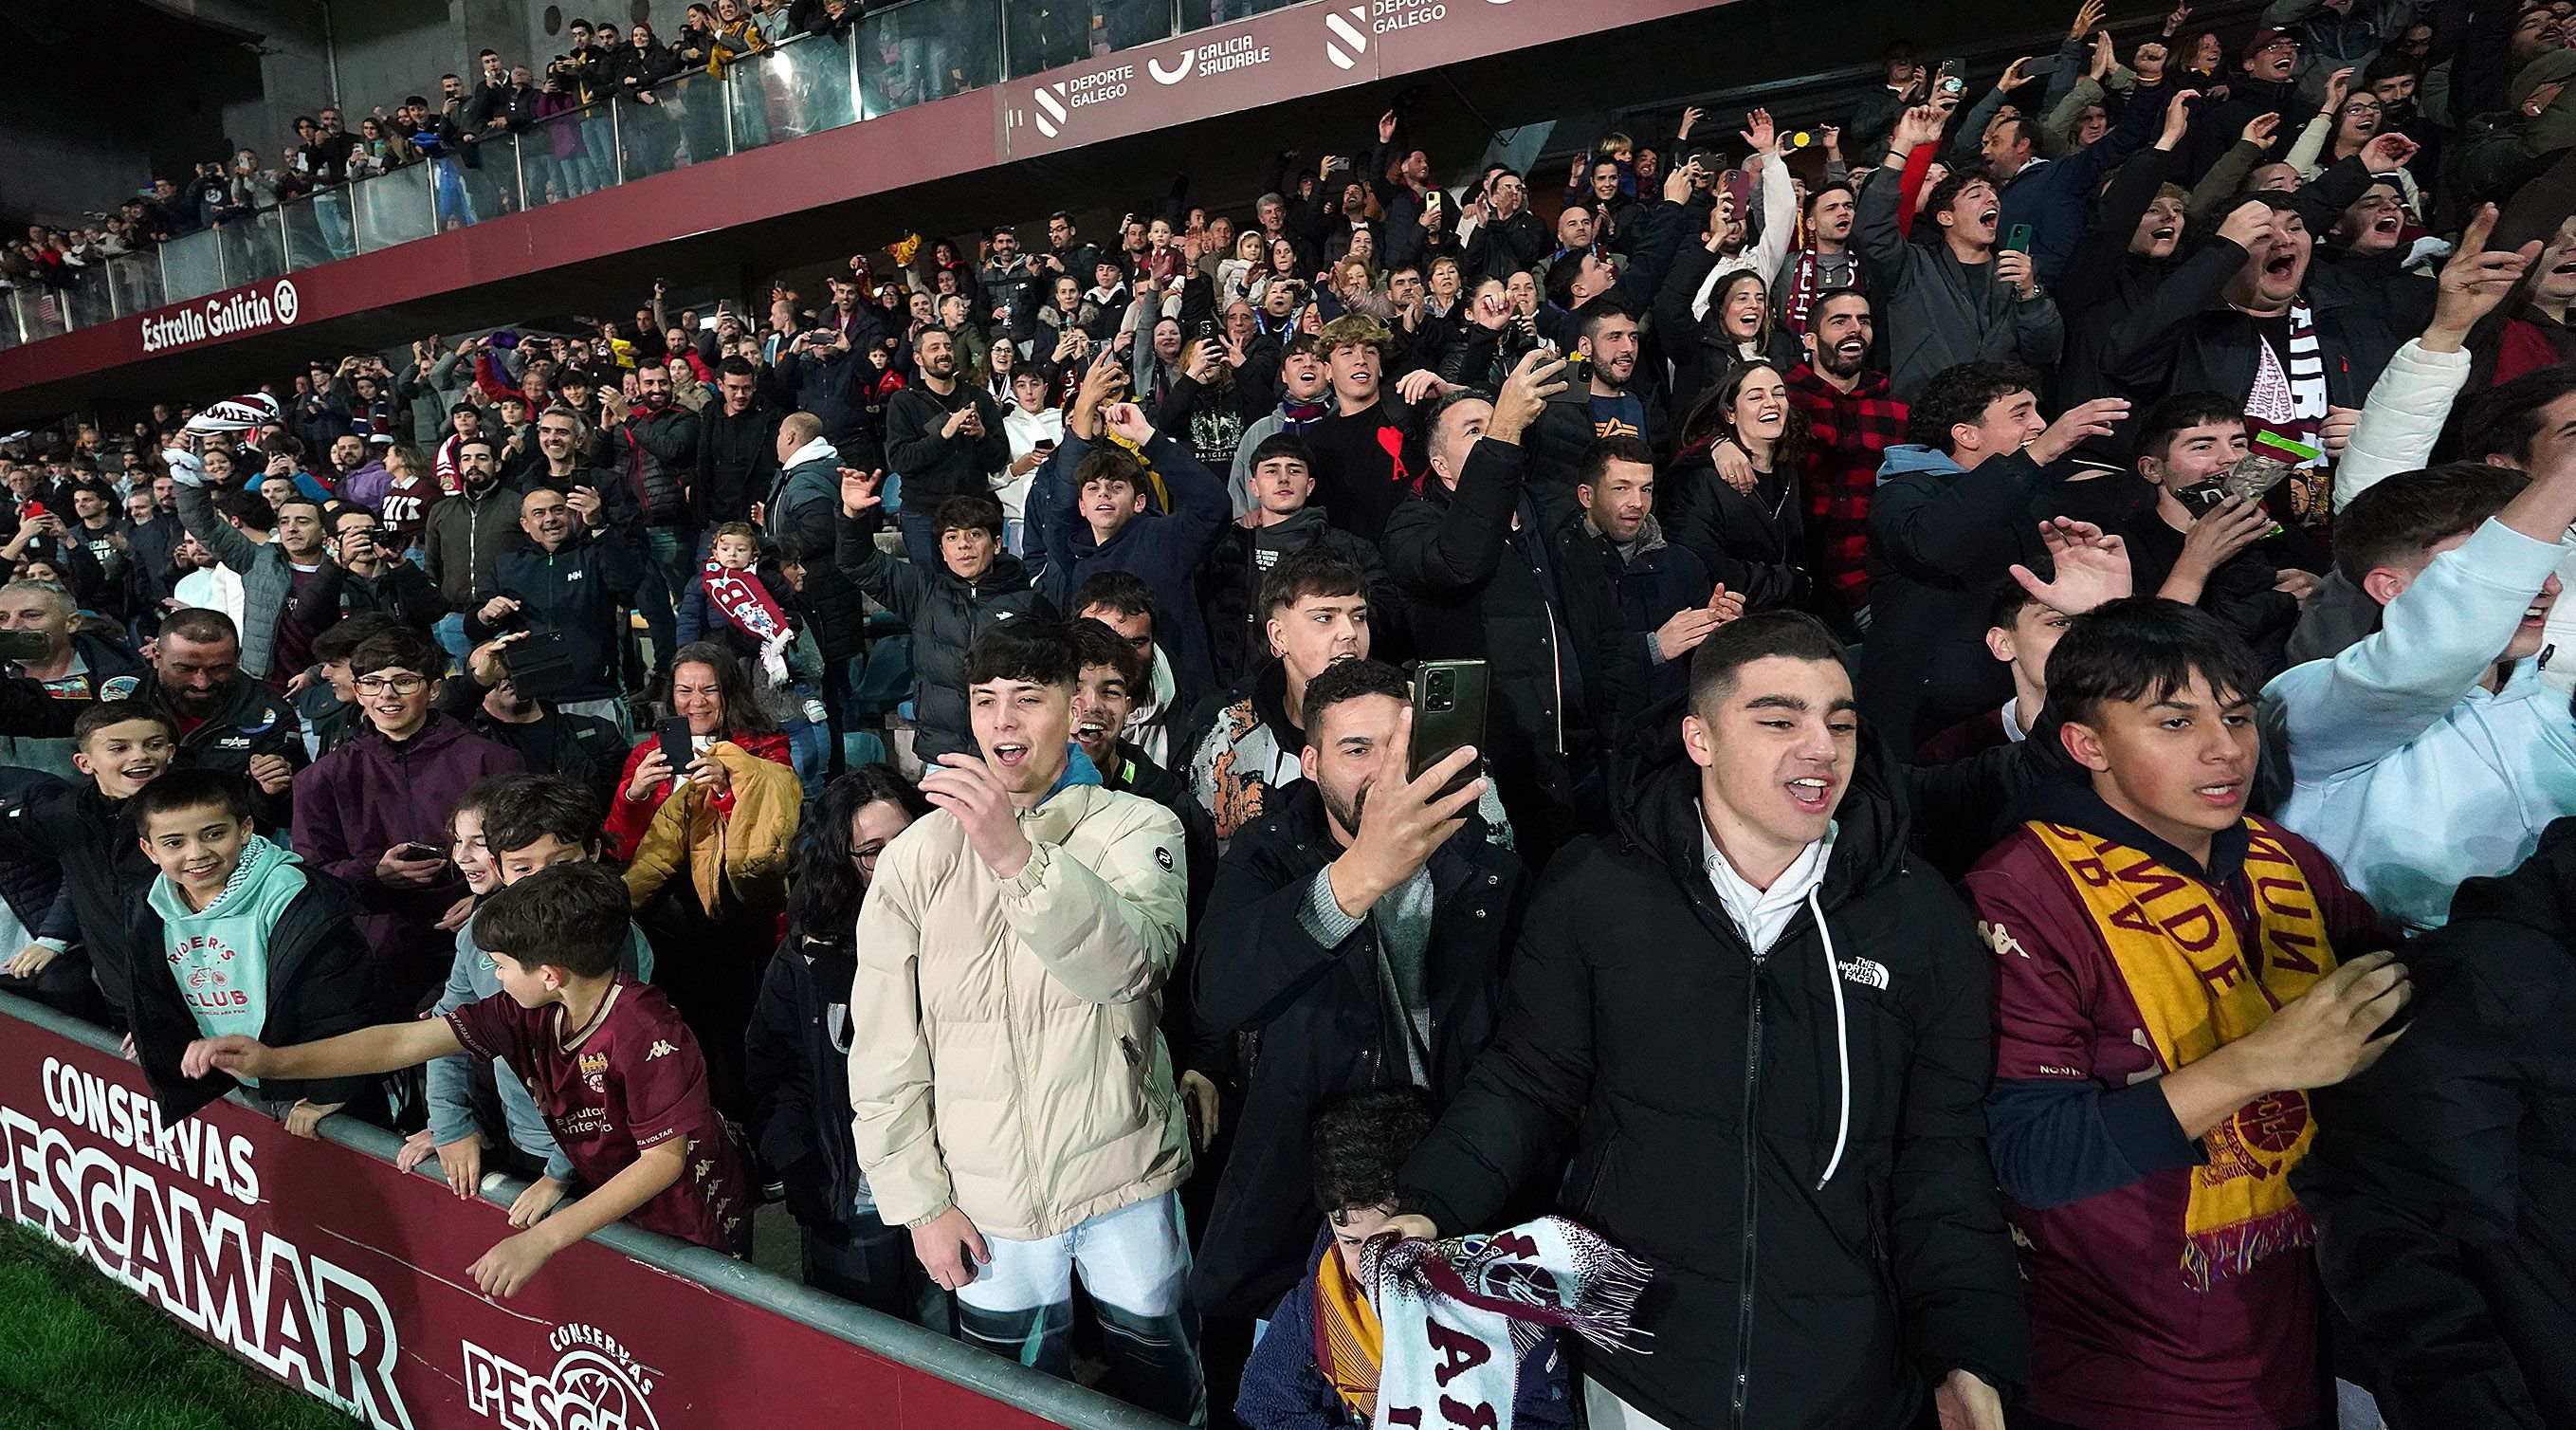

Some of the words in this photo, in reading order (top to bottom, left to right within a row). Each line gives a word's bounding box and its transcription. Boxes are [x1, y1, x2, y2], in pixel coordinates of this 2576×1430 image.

[1373, 4, 1447, 34] GALEGO
[1197, 35, 1253, 62] GALICIA
[1198, 46, 1270, 77] SAUDABLE
[1069, 64, 1134, 93] DEPORTE
[1070, 82, 1127, 108] GALEGO
[142, 308, 207, 352] Estrella
[206, 289, 273, 338] Galicia
[167, 935, 236, 965] RIDER'S
[1855, 956, 1876, 970] THE
[1837, 960, 1873, 978] NORTH
[1844, 970, 1872, 985] FACE
[185, 990, 248, 1007] CLUB
[646, 1128, 673, 1145] VOLTAR
[549, 1322, 654, 1397] CONSERVAS
